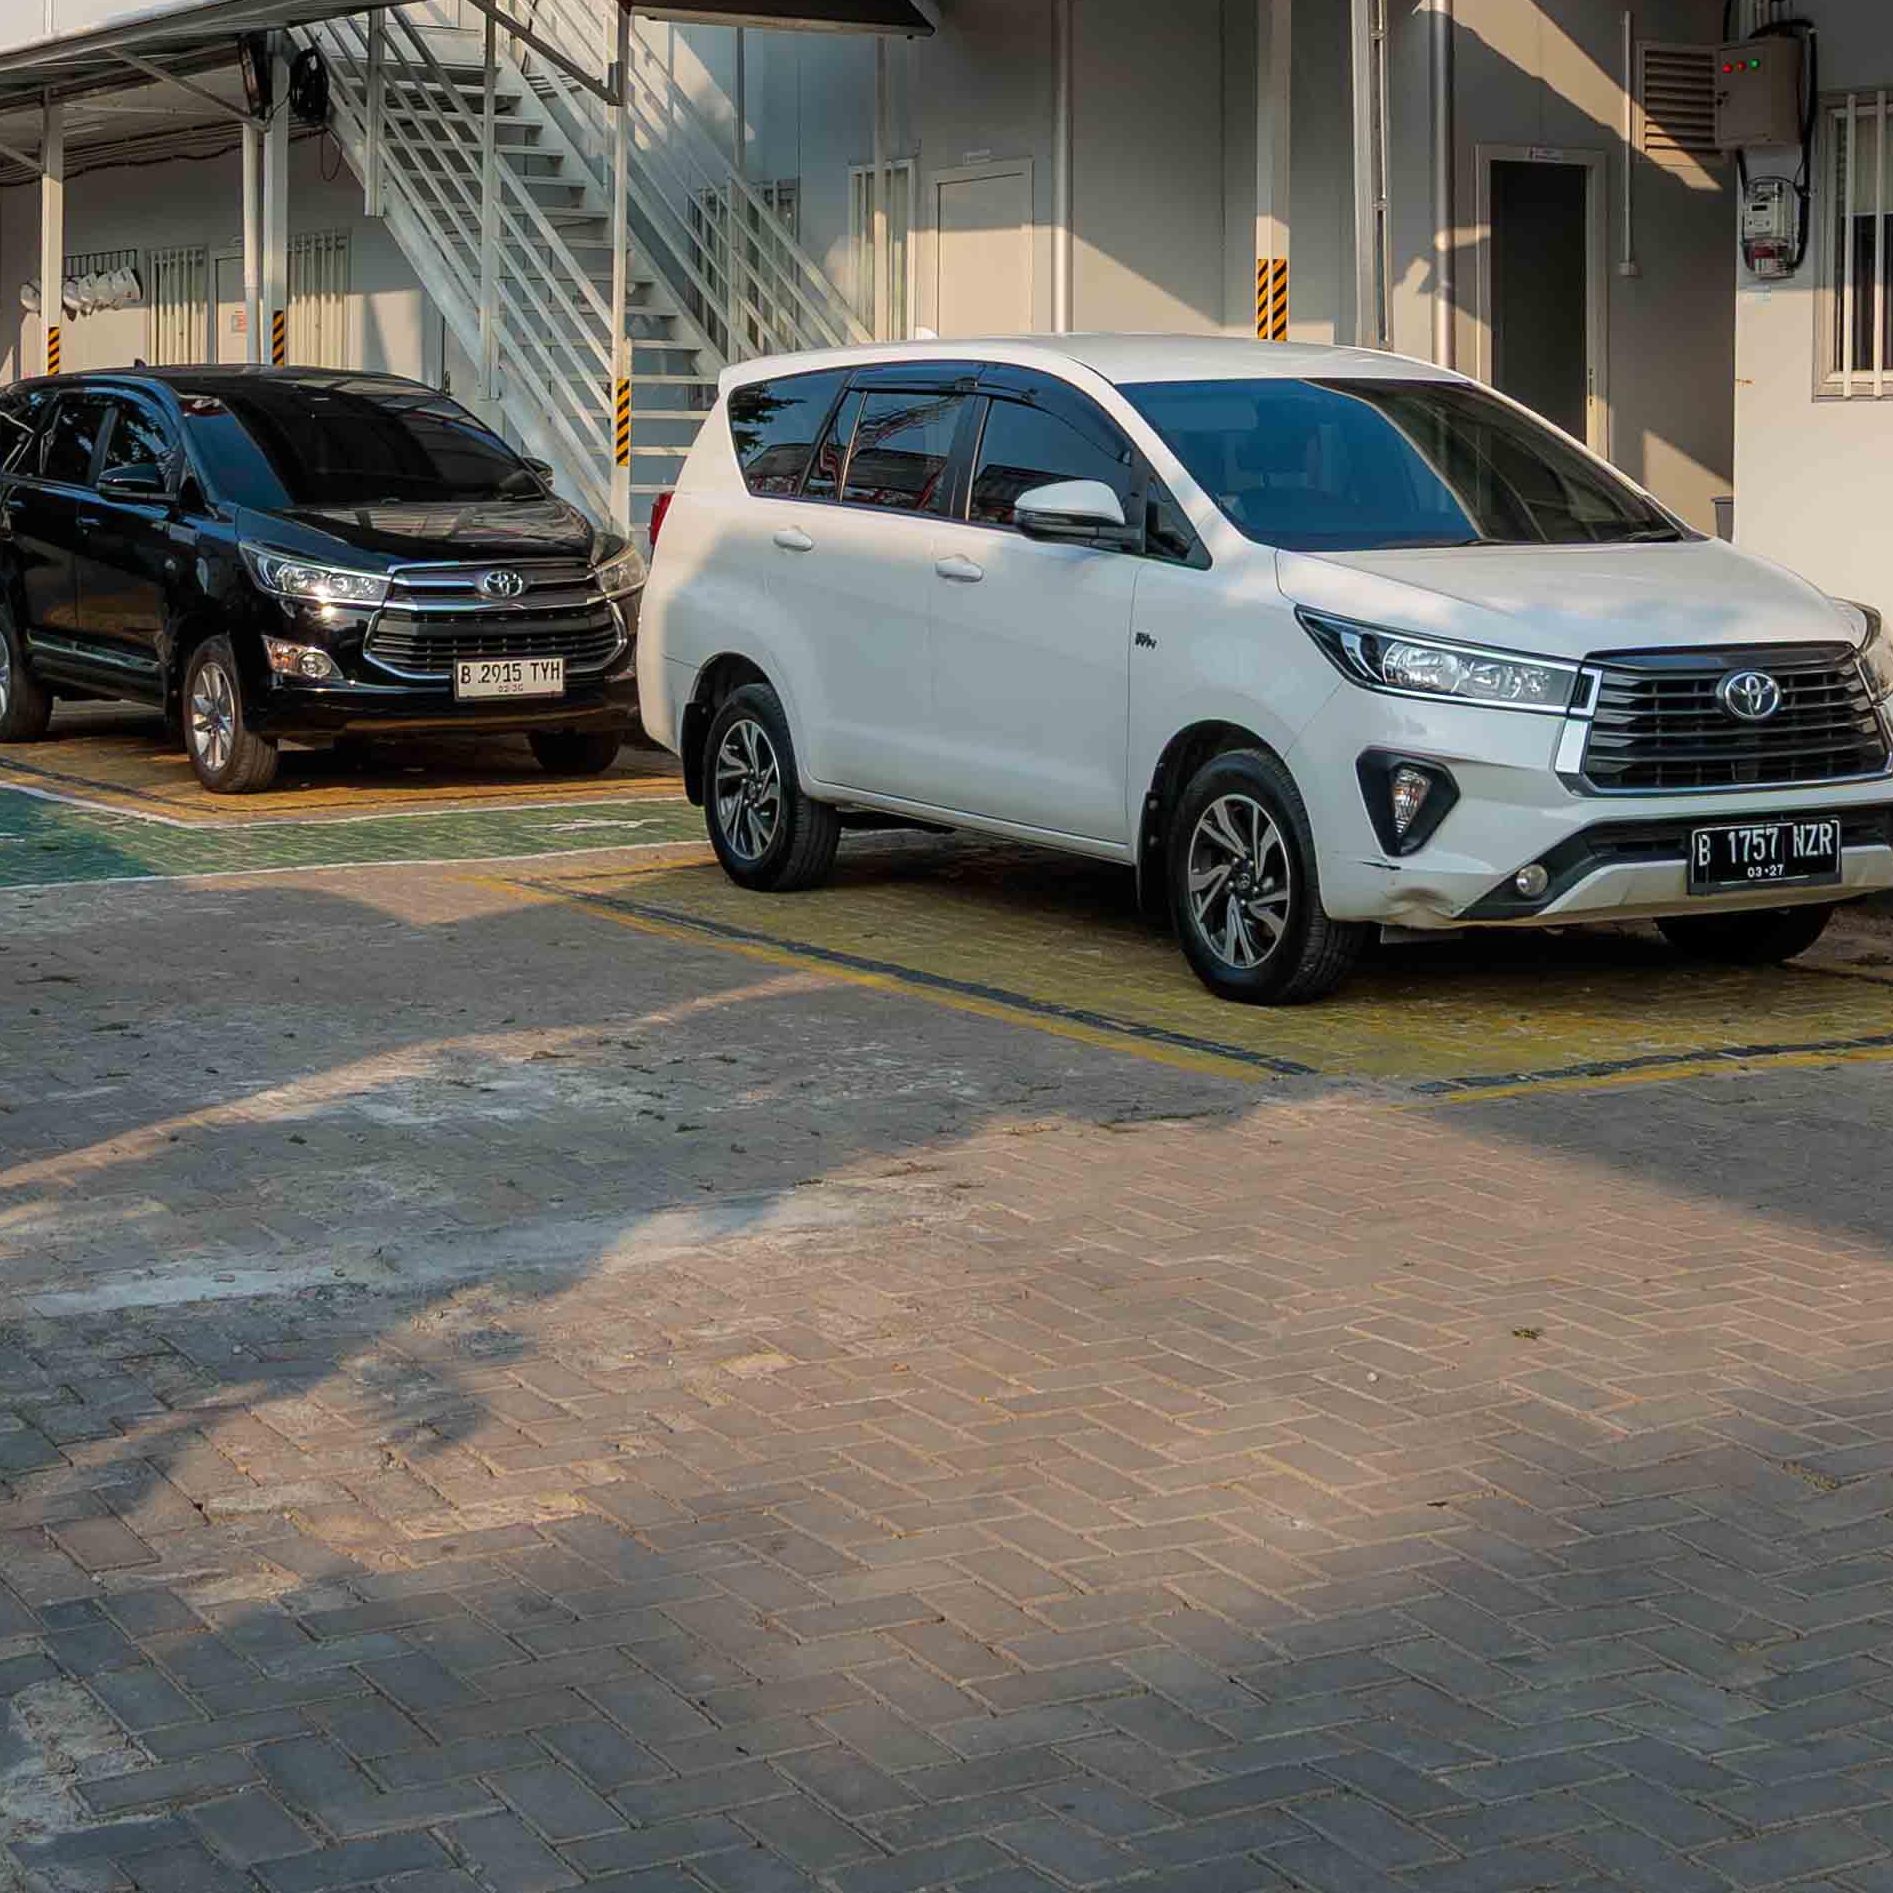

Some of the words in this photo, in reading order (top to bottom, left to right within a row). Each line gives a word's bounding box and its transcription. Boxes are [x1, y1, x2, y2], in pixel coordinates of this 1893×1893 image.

[461, 665, 471, 684] B
[480, 663, 522, 684] 2915
[530, 661, 560, 681] TYH
[1698, 834, 1711, 866] B
[1728, 826, 1779, 864] 1757
[1793, 823, 1833, 857] NZR
